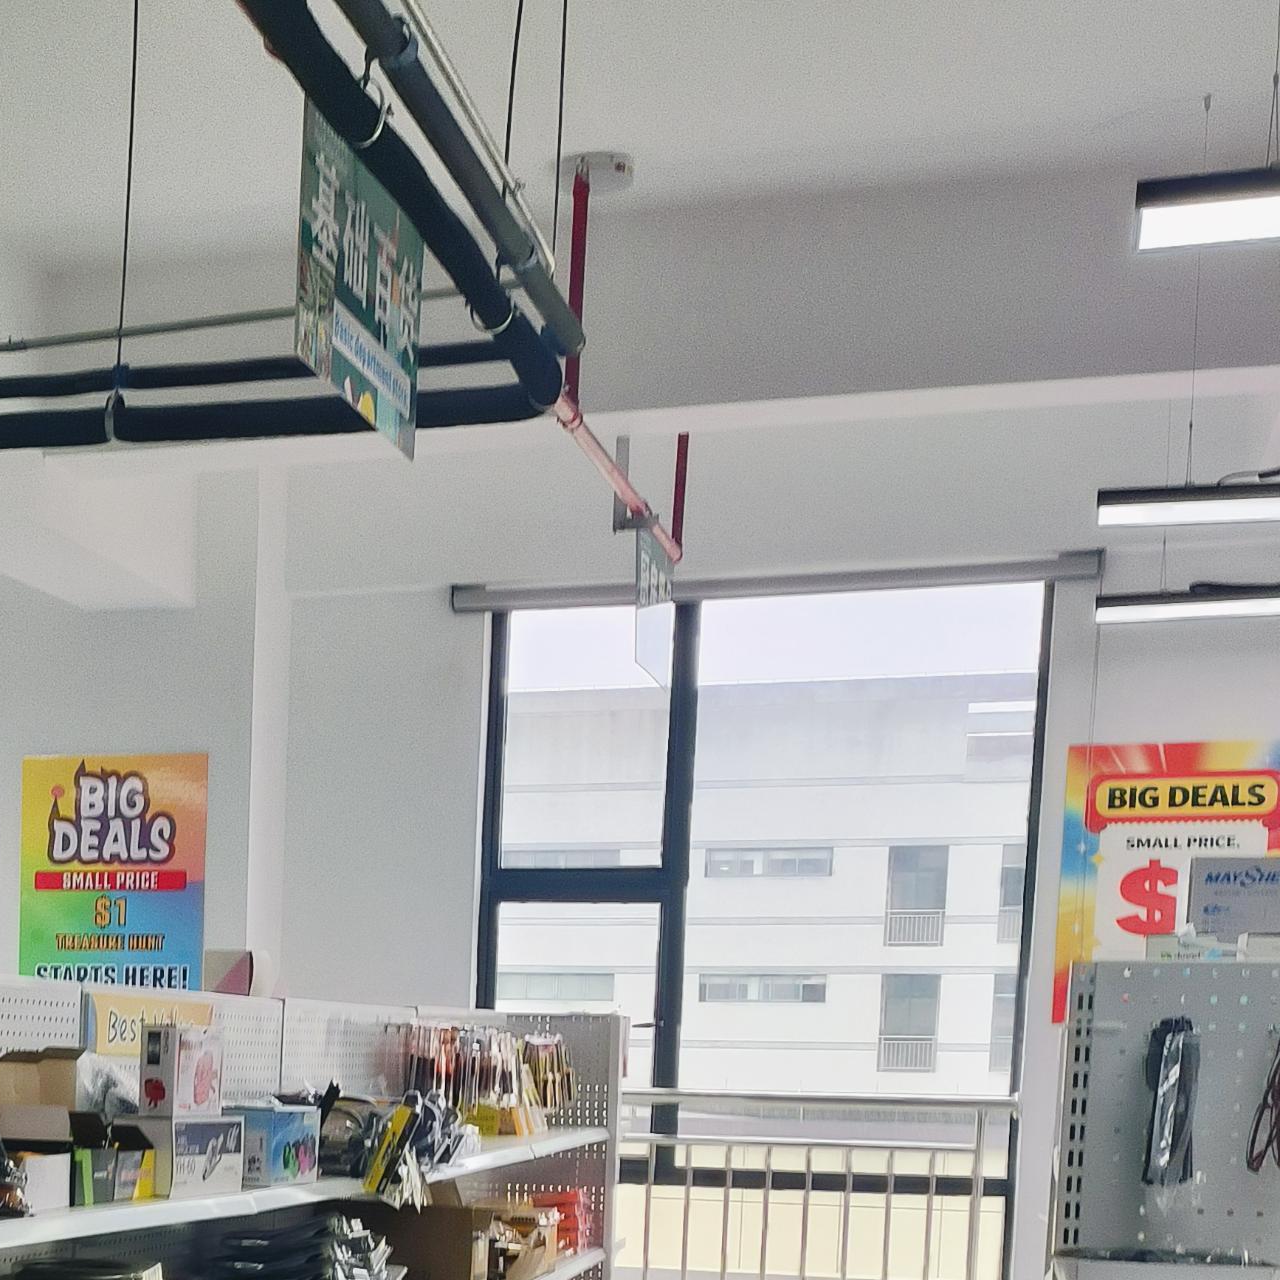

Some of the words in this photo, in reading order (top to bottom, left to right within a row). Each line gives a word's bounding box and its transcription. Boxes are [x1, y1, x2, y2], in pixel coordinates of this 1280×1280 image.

[79, 775, 145, 819] BIG
[1107, 786, 1159, 810] BIG
[1168, 783, 1266, 808] DEALS
[53, 816, 171, 862] DEALS
[1126, 836, 1183, 850] SMALL
[62, 871, 112, 890] SMALL
[116, 871, 159, 890] PRICE
[94, 895, 128, 928] $1
[56, 932, 124, 951] TREASURE
[128, 932, 165, 951] HUNT
[35, 964, 116, 984] STARTS
[124, 964, 189, 989] HERE!
